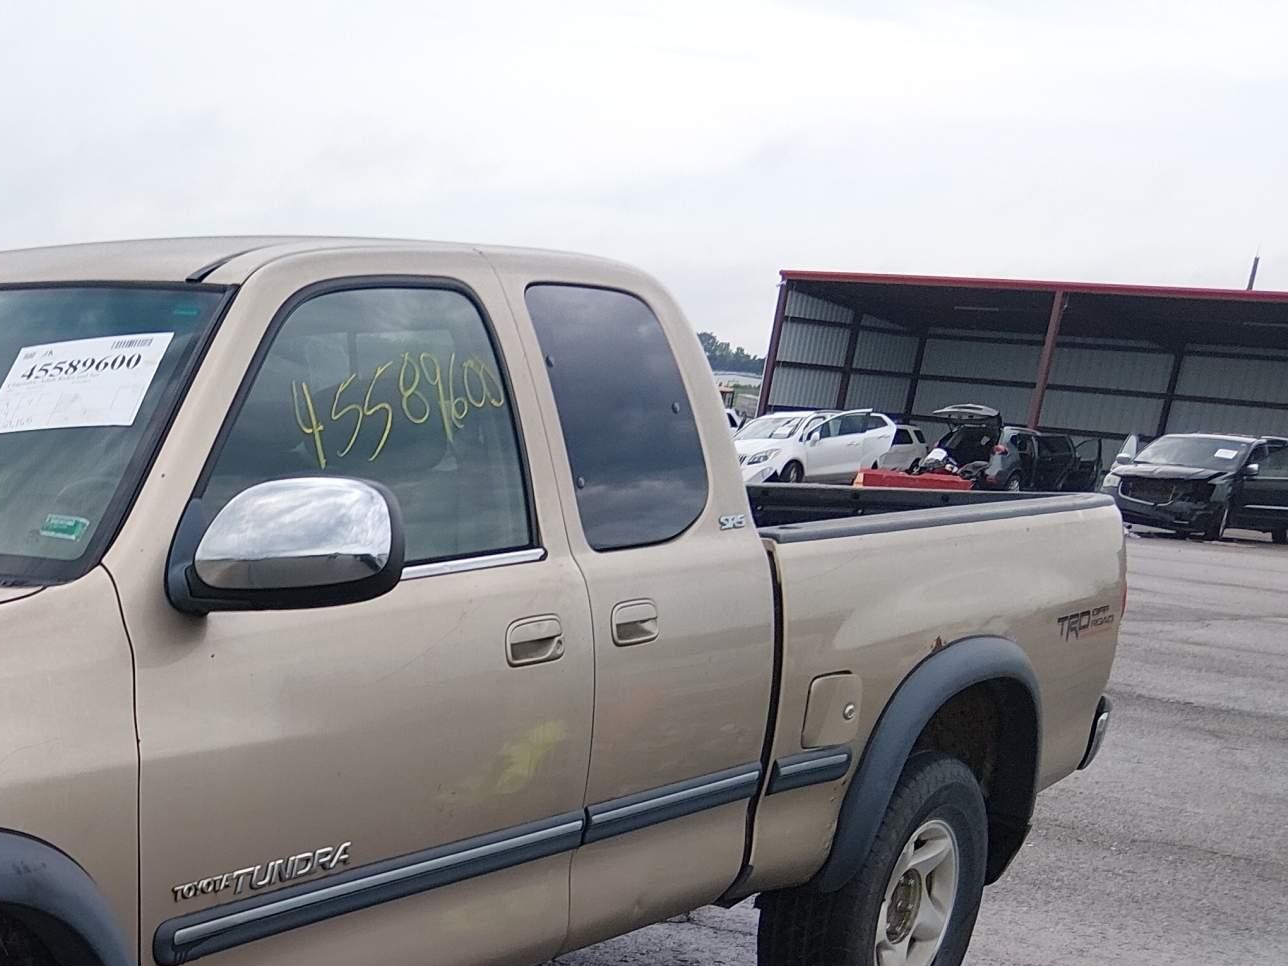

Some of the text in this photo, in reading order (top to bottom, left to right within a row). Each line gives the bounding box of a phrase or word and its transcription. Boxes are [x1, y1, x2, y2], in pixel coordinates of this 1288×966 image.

[21, 352, 142, 381] 45589600
[291, 352, 505, 471] 45589600
[1057, 609, 1091, 643] TRD
[172, 841, 352, 902] TOYOTA TUNDRA
